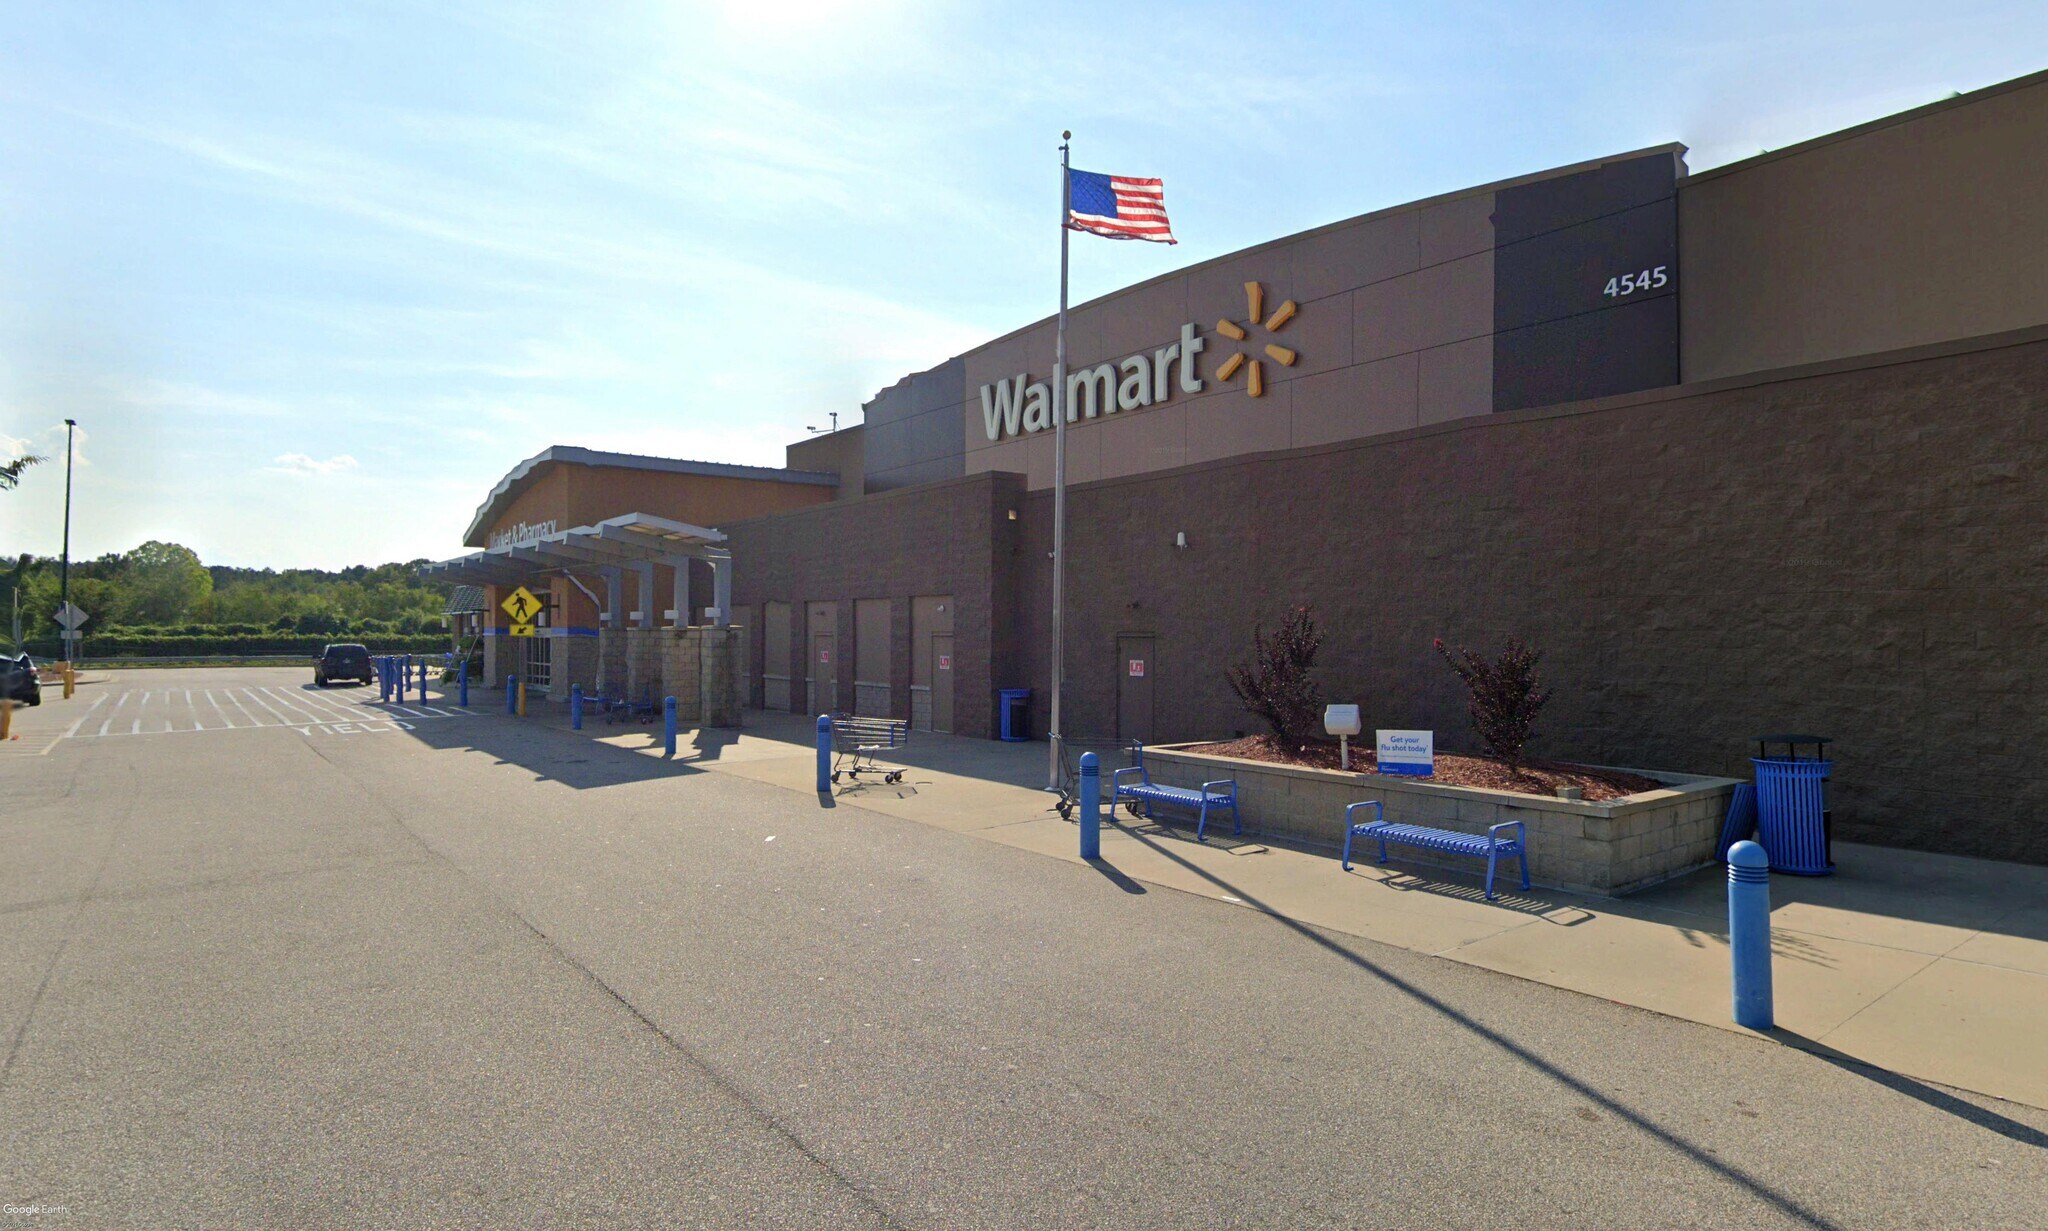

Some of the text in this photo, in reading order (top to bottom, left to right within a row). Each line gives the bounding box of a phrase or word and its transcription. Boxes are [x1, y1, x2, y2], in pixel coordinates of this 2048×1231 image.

[1603, 265, 1668, 297] 4545
[980, 322, 1204, 441] Walmart
[519, 520, 556, 541] Pharmacy
[290, 721, 416, 736] YIELD
